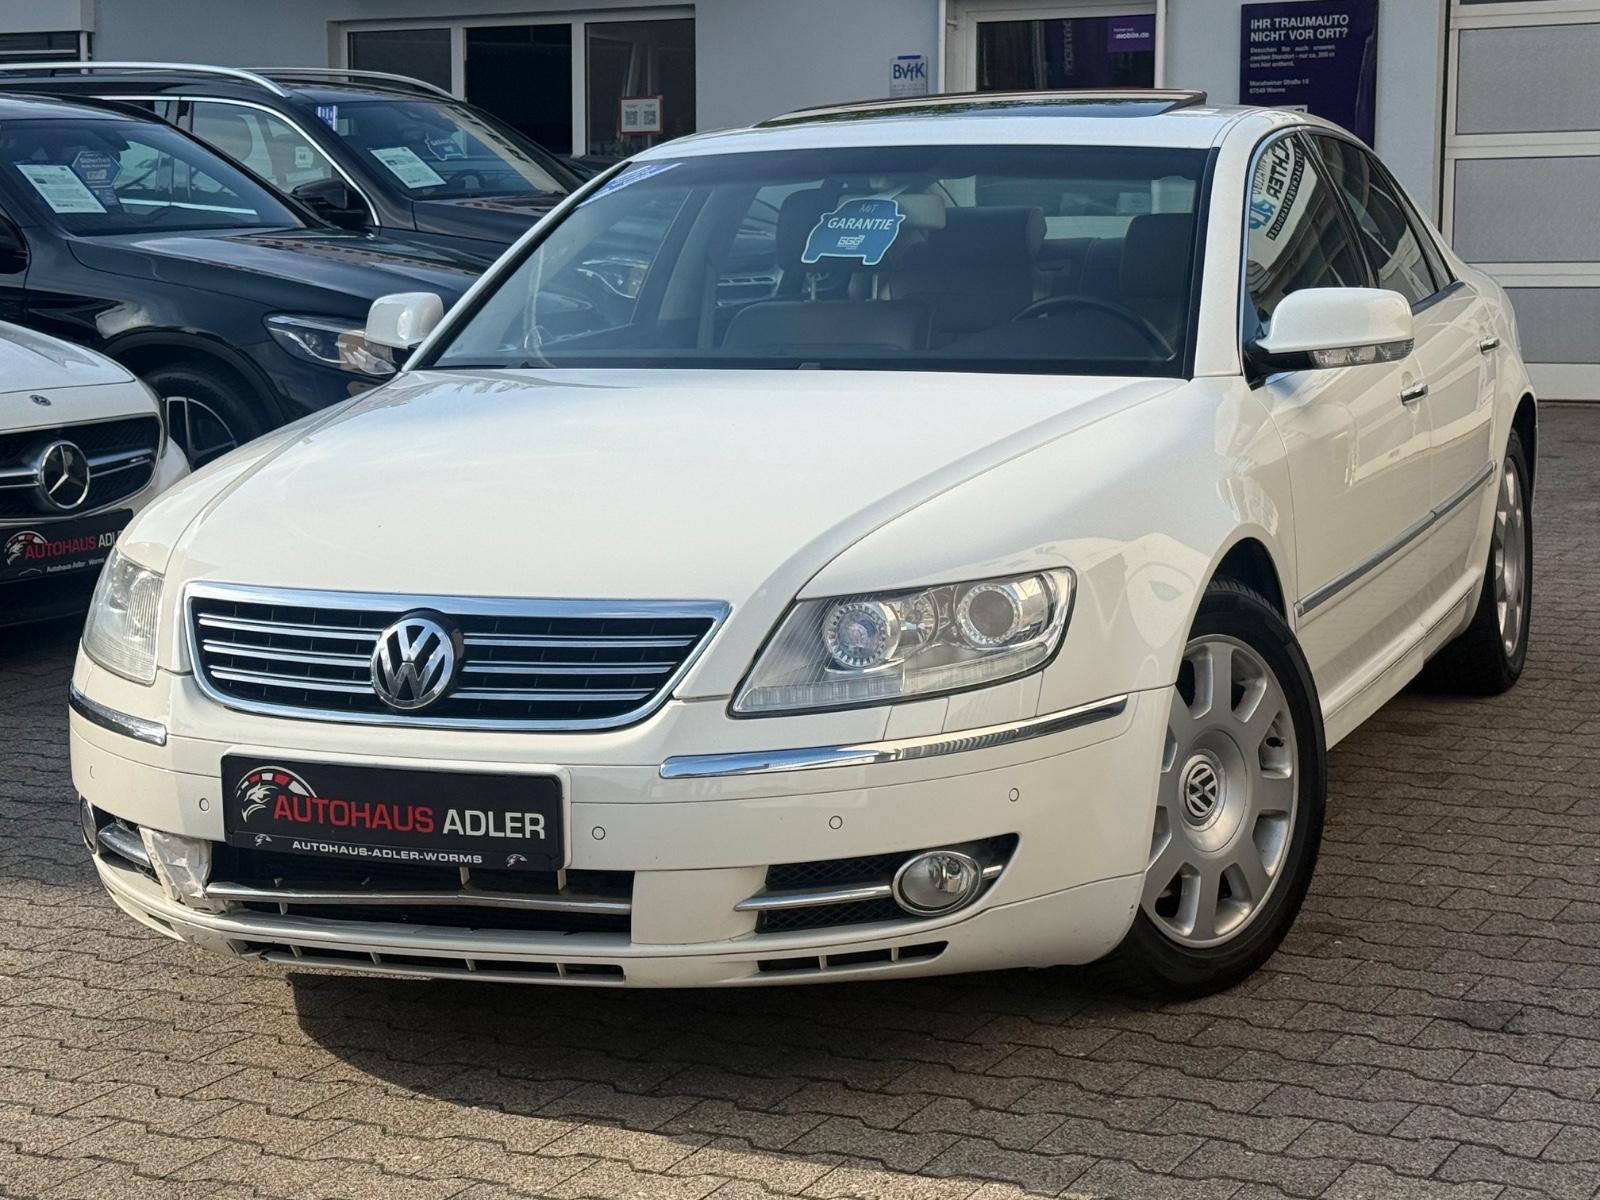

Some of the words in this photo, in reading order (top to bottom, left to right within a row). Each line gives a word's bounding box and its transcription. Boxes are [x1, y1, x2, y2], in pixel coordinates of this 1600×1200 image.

[1250, 19, 1271, 30] IHR
[1273, 14, 1349, 28] TRAUMAUTO
[1250, 30, 1286, 42] NICHT
[1288, 29, 1314, 40] VOR
[1316, 27, 1349, 39] ORT?
[893, 62, 926, 80] BvfK
[827, 217, 894, 230] GARANTIE
[24, 535, 96, 560] AUTOHAUS
[98, 530, 122, 548] ADL
[273, 794, 435, 834] AUTOHAUS
[442, 808, 546, 840] ADLER
[292, 840, 483, 864] AUTOHAUS-ADLER-WORMS
